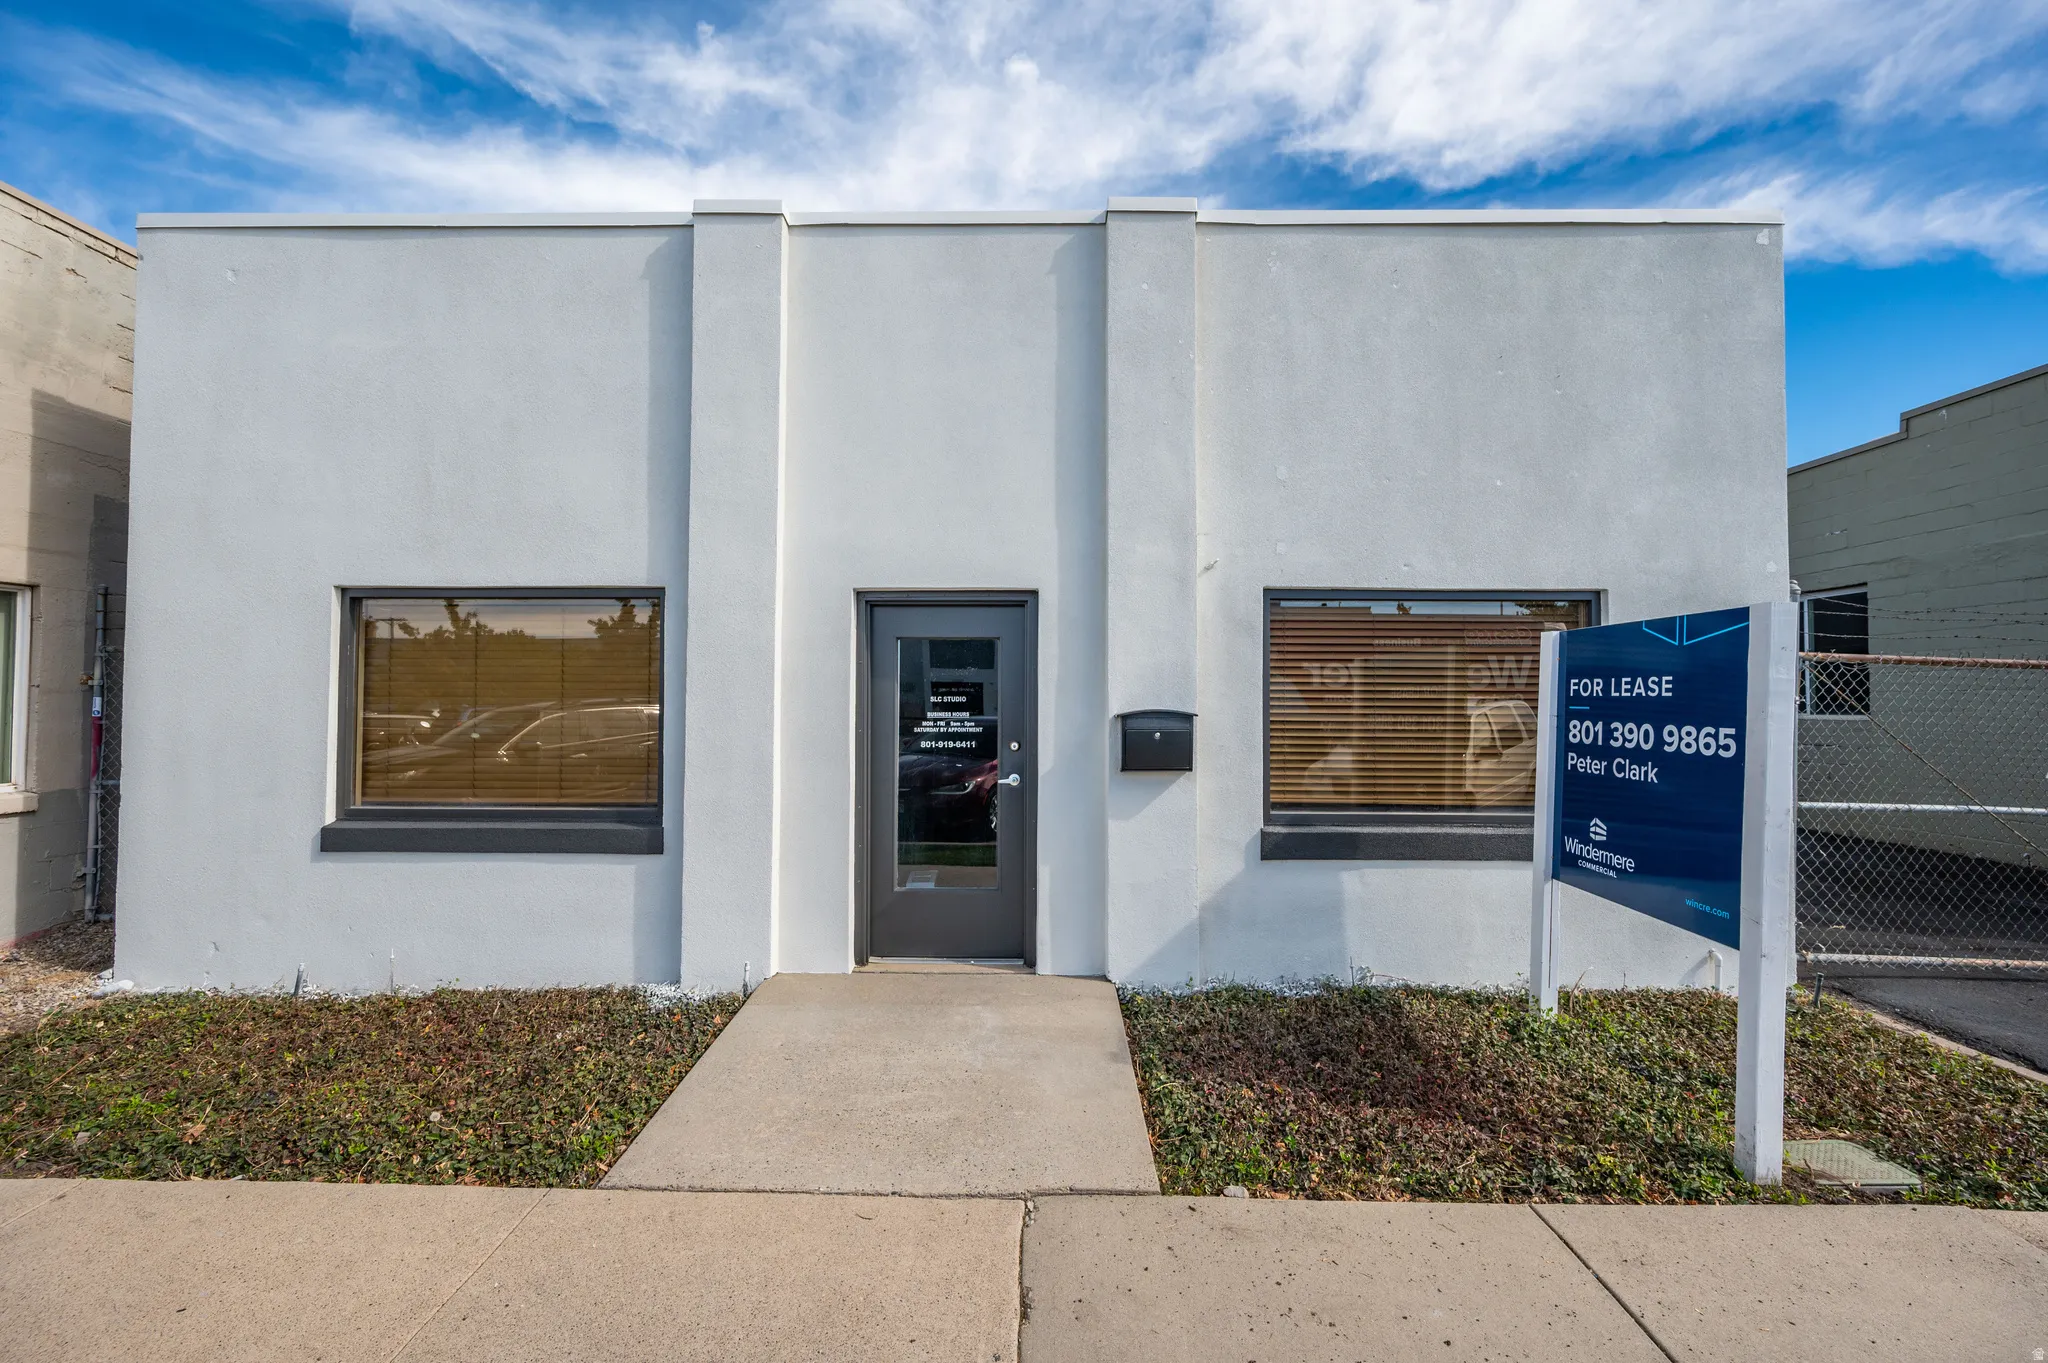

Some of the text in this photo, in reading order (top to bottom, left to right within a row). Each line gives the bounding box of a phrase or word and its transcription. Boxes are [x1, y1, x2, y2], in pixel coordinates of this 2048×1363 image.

[1570, 676, 1673, 697] FOR LEASE
[920, 740, 976, 748] 801-919-6411
[1568, 719, 1737, 758] 801 390 9865
[1567, 752, 1659, 783] Peter Clark
[1564, 836, 1635, 872] Windermere
[1578, 859, 1617, 878] COMMERCIAL
[1685, 898, 1730, 919] wincre.com
